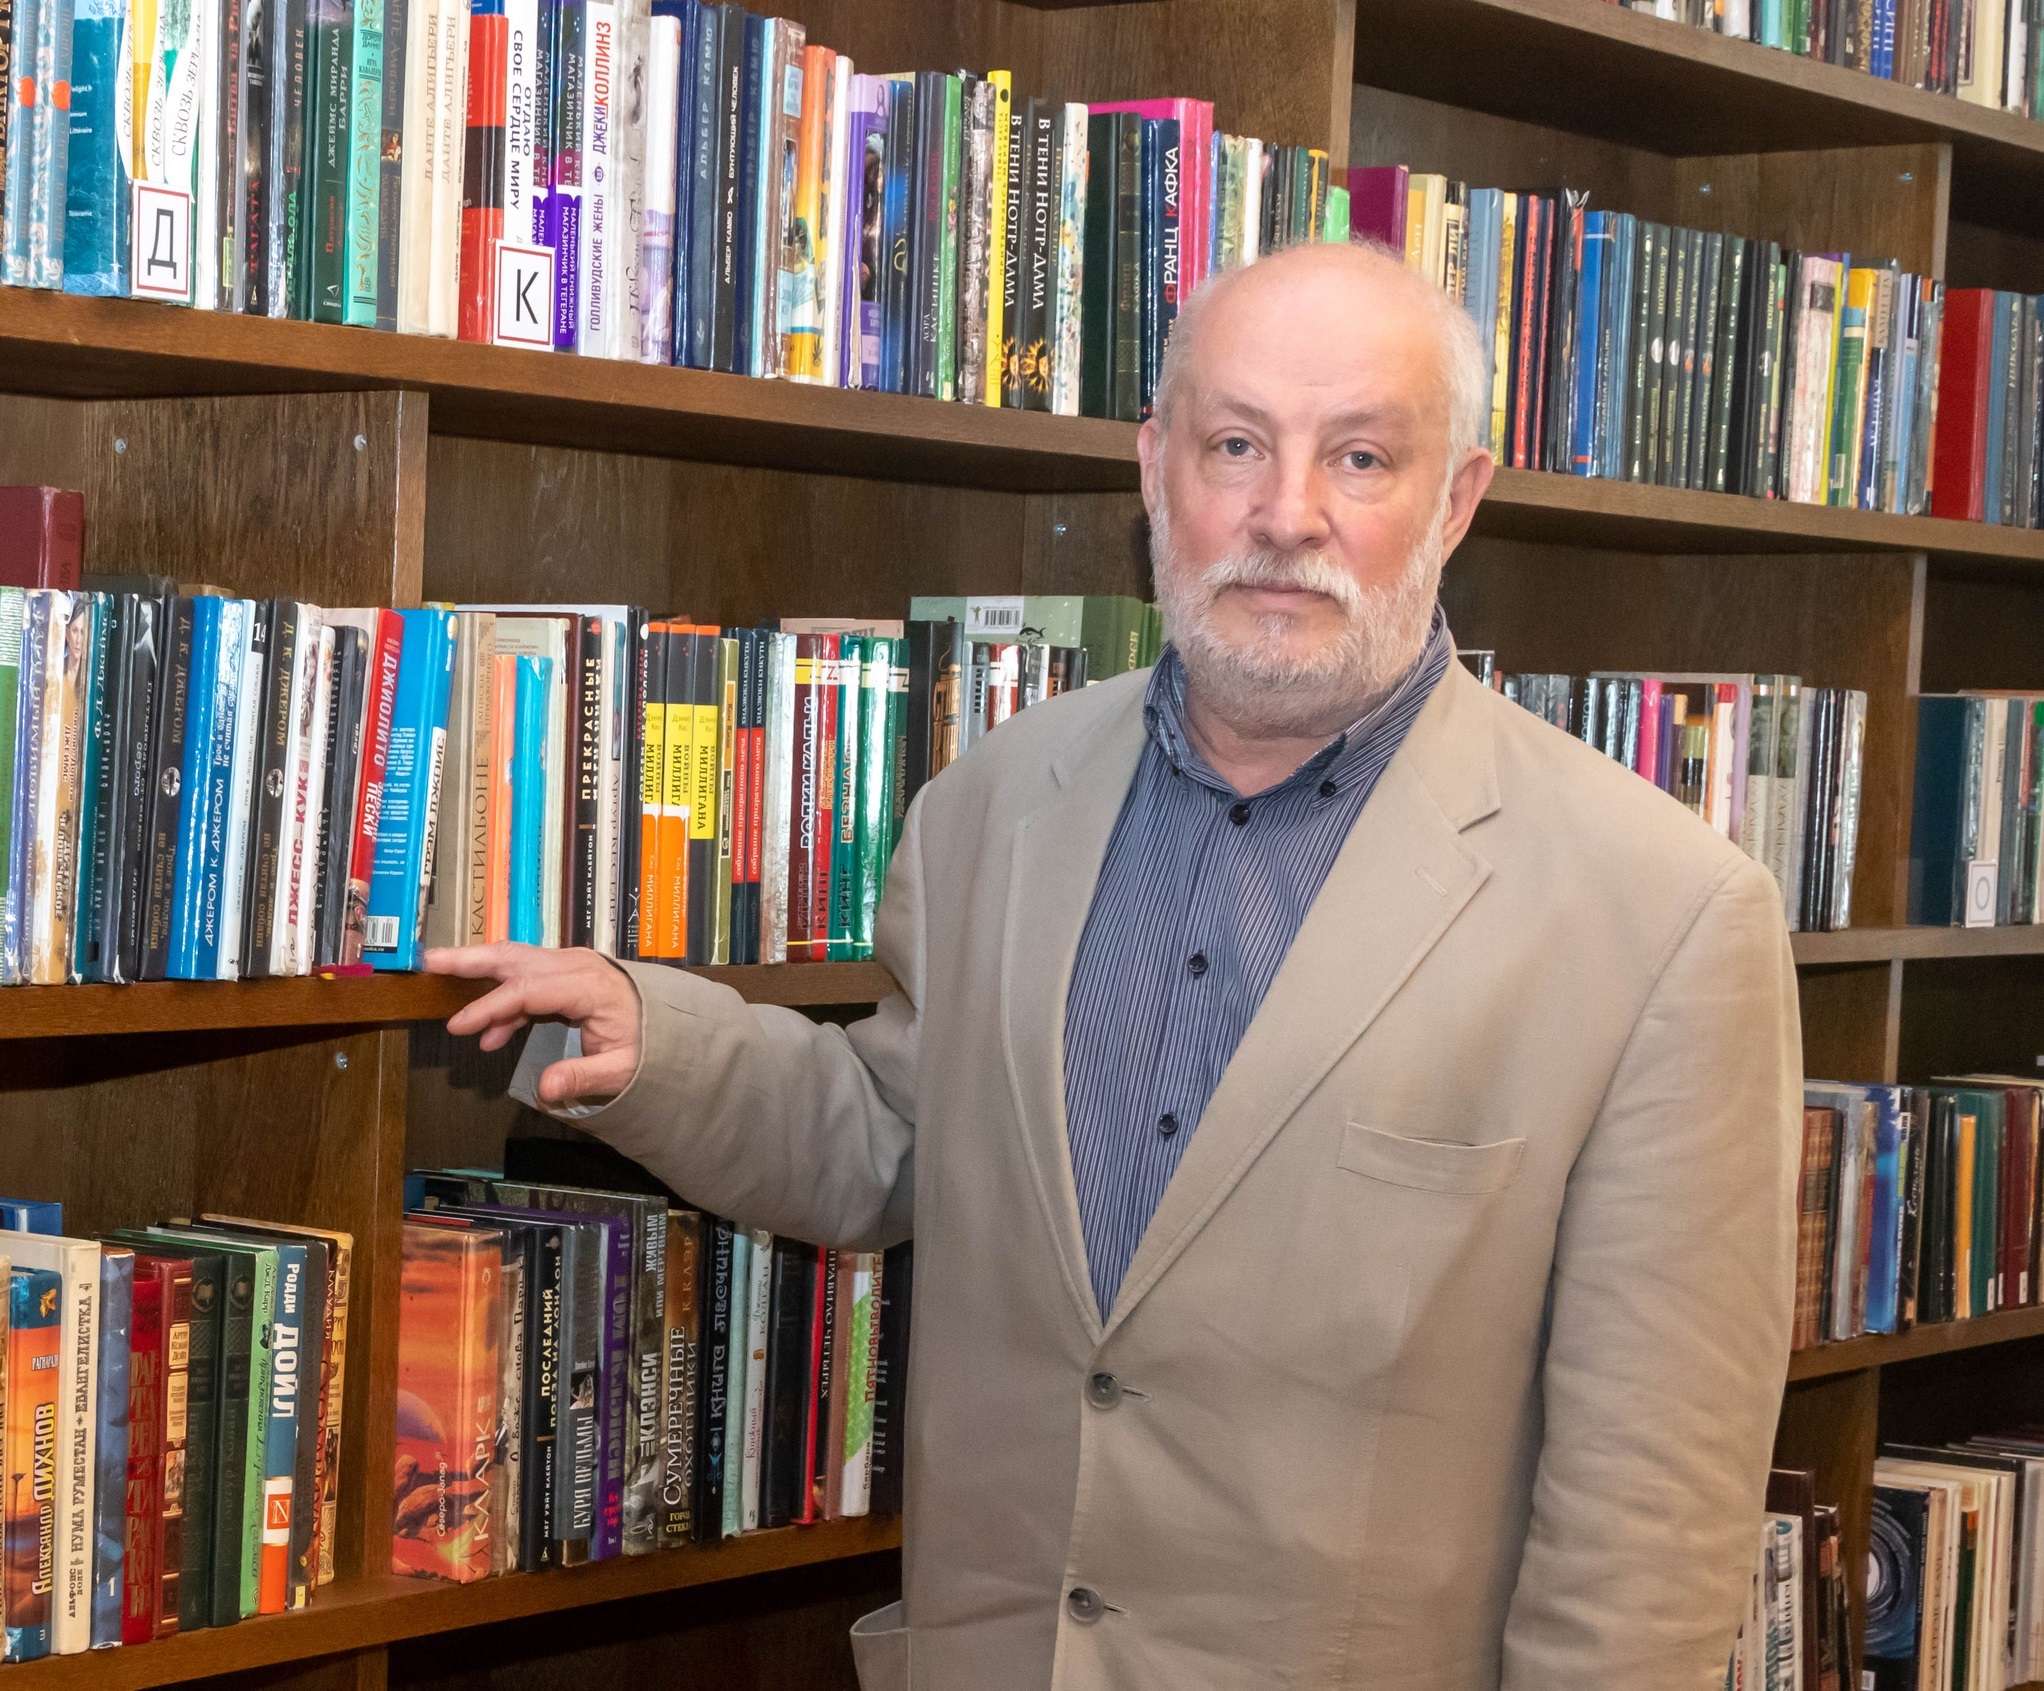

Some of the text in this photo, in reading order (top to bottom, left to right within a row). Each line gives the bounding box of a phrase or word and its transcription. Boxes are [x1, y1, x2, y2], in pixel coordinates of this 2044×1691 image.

[123, 67, 132, 138] СКВОЗЬ
[293, 28, 304, 106] ЧЕЛОВЕК
[327, 28, 340, 168] ДЖЕЙМС МИРАНДА
[338, 65, 348, 130] БАРРИ
[424, 14, 438, 183] ДАНТЕ АЛИГЬЕРИ
[441, 15, 456, 184] ДАНТЕ АЛИГЬЕРИ
[534, 48, 544, 146] МАГАЗИНЧИК
[575, 56, 583, 153] МАЛЕНЬКИЙ
[592, 21, 611, 154] ДЖЕКИ КОЛЛИНЗ
[700, 25, 713, 179] АЛЬБЕР КАМЮ
[731, 65, 739, 112] ЧЕЛОВЕК
[151, 98, 163, 167] СКВОЗЬ
[171, 89, 193, 156] СКВОЗЬ
[510, 30, 523, 209] СВОЕ СЕРДЦЕ МИРУ
[523, 87, 532, 157] ОТДАЮ
[565, 53, 576, 164] МАГАЗИНЧИК В
[728, 114, 737, 178] БУНТУЮЩИЙ
[1005, 115, 1022, 308] В ТЕНИ НОТР-ДАМА
[1032, 118, 1051, 310] В ТЕНИ НОТР-ДАМА
[1164, 146, 1179, 218] КАФКА
[147, 207, 177, 278] Д
[561, 206, 569, 275] МАГАЗИНЧИК
[590, 193, 604, 331] ГОЛЛИВУДСКИЕ ЖЕНЫ
[1163, 227, 1179, 305] ФРАНЦ
[1448, 227, 1458, 255] ЛИ
[516, 269, 539, 325] К
[559, 286, 567, 334] ТЕГЕРАНЕ
[254, 622, 267, 642] 14
[171, 617, 191, 744] Д. К. ДЖЕРОМ
[276, 621, 295, 745] Д. К. ДЖЕРОМ
[373, 653, 398, 767] ДЖИОЛИТО
[477, 674, 485, 725] ЗАПИСКИ
[28, 685, 41, 820] ЛЮБИМЫЙ
[213, 744, 222, 766] Трое
[223, 711, 233, 767] не считая
[581, 657, 595, 799] ПРЕКРАСНЫЕ
[133, 741, 142, 796] серого
[137, 682, 153, 852] Пятьдесят оттенков
[609, 773, 619, 829] Артур
[697, 744, 708, 830] МИЛЛИГАНА
[737, 763, 746, 828] призрачного
[752, 763, 761, 827] призрачного
[362, 782, 378, 837] ПЕСКИ
[471, 756, 489, 936] КАСТИЛЬОНЕ
[205, 778, 224, 946] ДЖЕРОМ К. ДЖЕРОМ
[423, 820, 435, 876] ГРЭМ
[736, 829, 744, 876] собрание
[751, 829, 759, 875] собрание
[150, 832, 166, 950] не считая собаки
[255, 832, 271, 949] не считая собаки
[645, 874, 655, 947] МИЛЛИГАНА
[671, 875, 681, 949] МИЛЛИГАНА
[839, 863, 853, 928] КИНГ
[1974, 876, 1990, 911] О
[645, 1214, 657, 1272] ЖИВЫМ
[656, 1213, 666, 1318] ИЛИ МЕРТВЫМ
[683, 1235, 693, 1291] КЛЭР
[271, 1263, 300, 1418] Родди ДОЙЛ
[325, 1269, 335, 1340] КЛАУДИЯ
[541, 1288, 553, 1397] ПОСЛЕДНИЙ
[612, 1274, 629, 1339] ТОМ
[821, 1250, 836, 1399] ПРАВИЛО ЧЕТЫРЕХ
[553, 1339, 559, 1362] НА
[710, 1344, 727, 1419] КНИГА
[71, 1295, 91, 1552] НУМА РУМЕСТАН ЕВАНГЕЛИСТКА
[640, 1352, 657, 1442] КЛЭНСИ
[663, 1325, 685, 1506] СУМЕРЕЧНЫЕ
[684, 1341, 696, 1487] ОХОТНИКИ
[745, 1406, 757, 1460] Книжный
[33, 1403, 55, 1502] ДИХНОВ
[473, 1418, 491, 1541] КЛАРК
[573, 1415, 593, 1529] БУРЯ ВЕДЬМЫ
[437, 1459, 448, 1538] Северо-Запад
[68, 1568, 76, 1618] АЛЬФОНС
